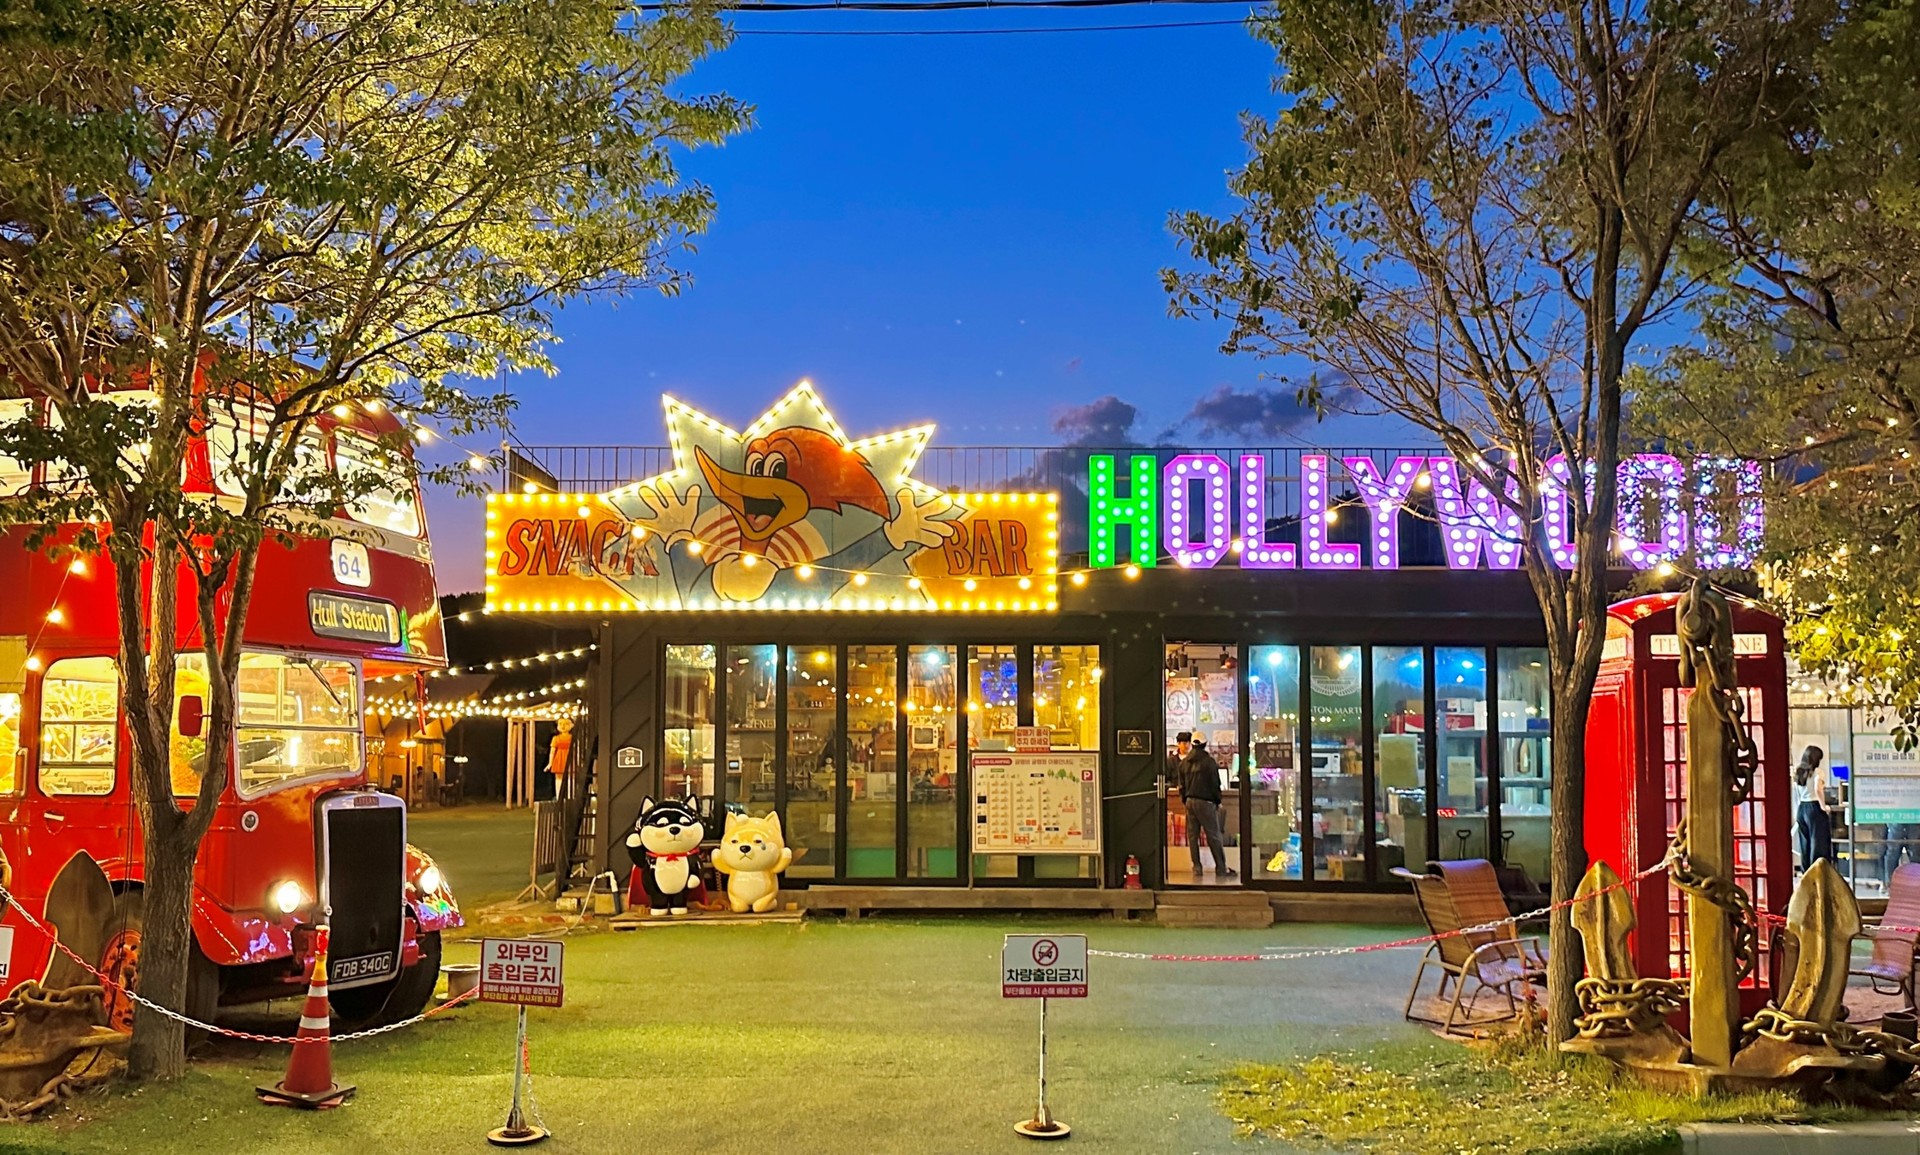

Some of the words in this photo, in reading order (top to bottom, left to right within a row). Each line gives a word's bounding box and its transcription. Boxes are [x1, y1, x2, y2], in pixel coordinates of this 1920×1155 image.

[1088, 453, 1764, 570] HOLLYWOOD
[497, 518, 660, 577] SNACK
[943, 518, 1034, 577] BAR
[338, 553, 361, 578] 64
[312, 598, 339, 628] Hull
[341, 602, 387, 633] Station
[624, 756, 635, 765] 64
[1083, 771, 1092, 779] P
[497, 943, 549, 962] 외부인
[334, 961, 358, 979] FDB
[360, 955, 390, 974] 340C
[487, 962, 556, 984] 출입금지
[1006, 968, 1084, 982] 차량출입금지
